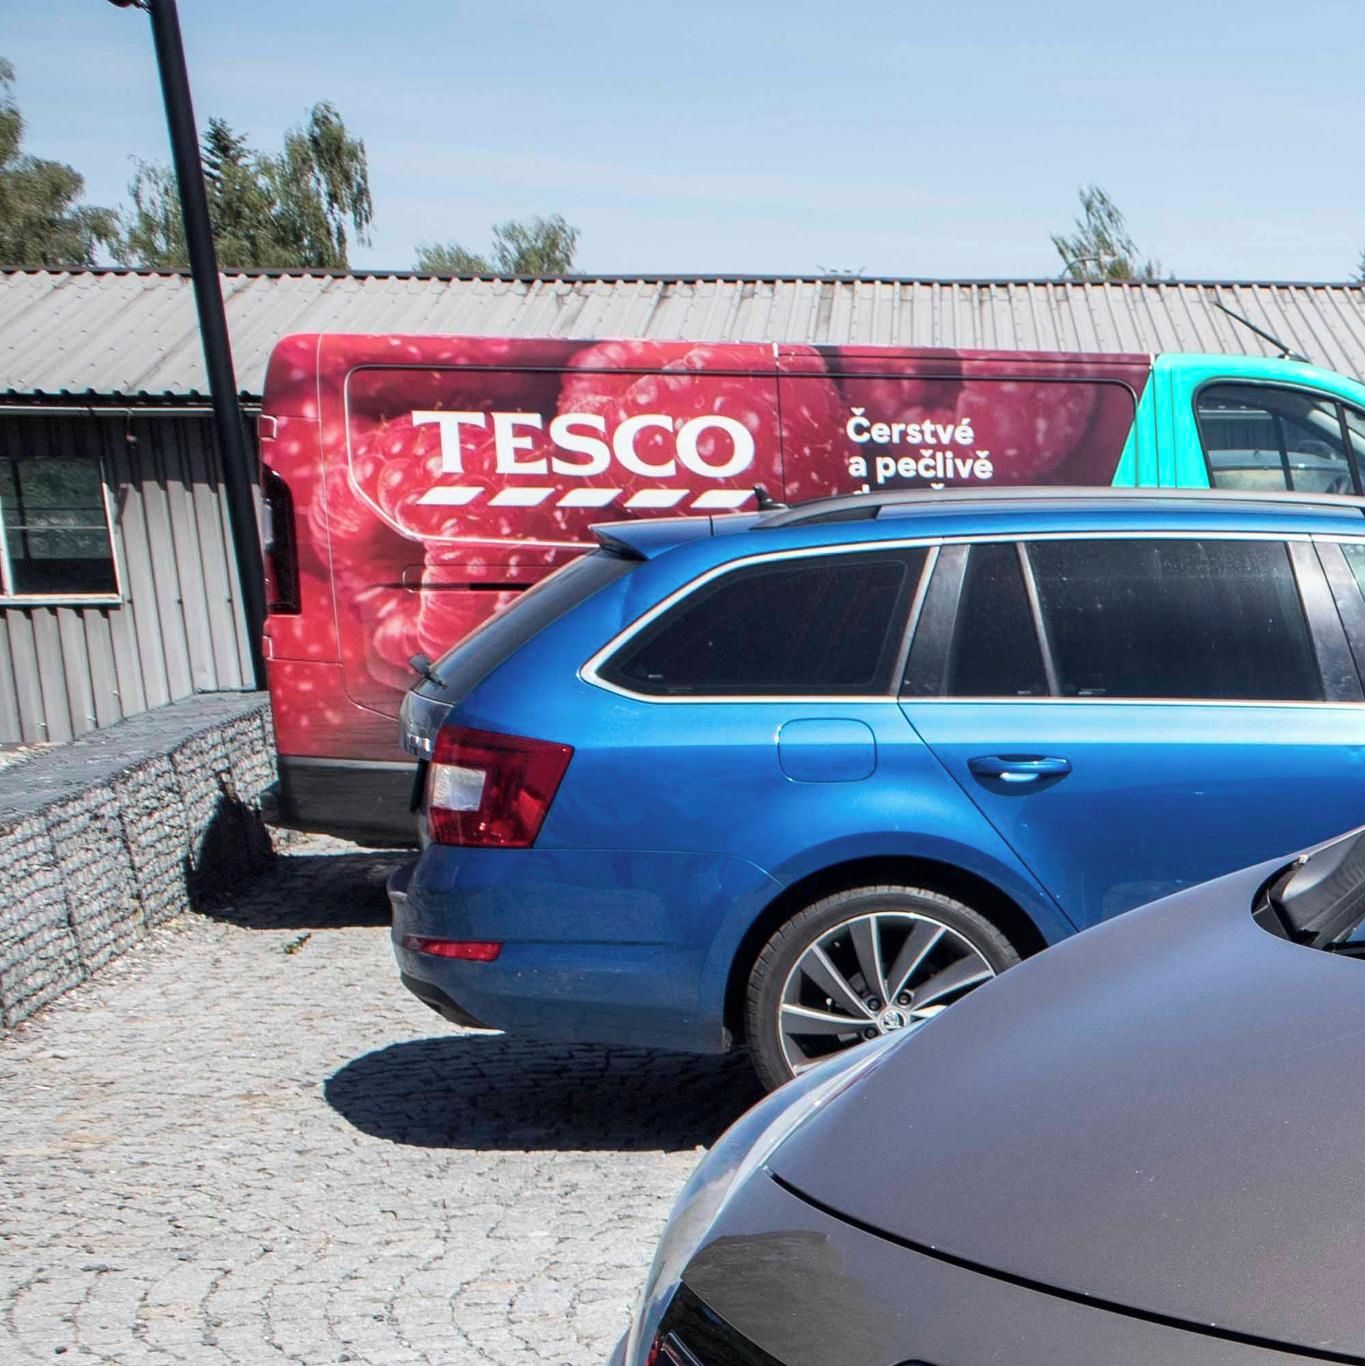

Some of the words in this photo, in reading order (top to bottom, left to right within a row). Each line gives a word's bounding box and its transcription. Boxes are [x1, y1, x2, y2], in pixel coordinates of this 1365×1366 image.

[412, 410, 755, 478] TESCO
[846, 407, 975, 445] Čerstvé
[848, 456, 867, 477] a
[875, 449, 994, 484] pečlivě
